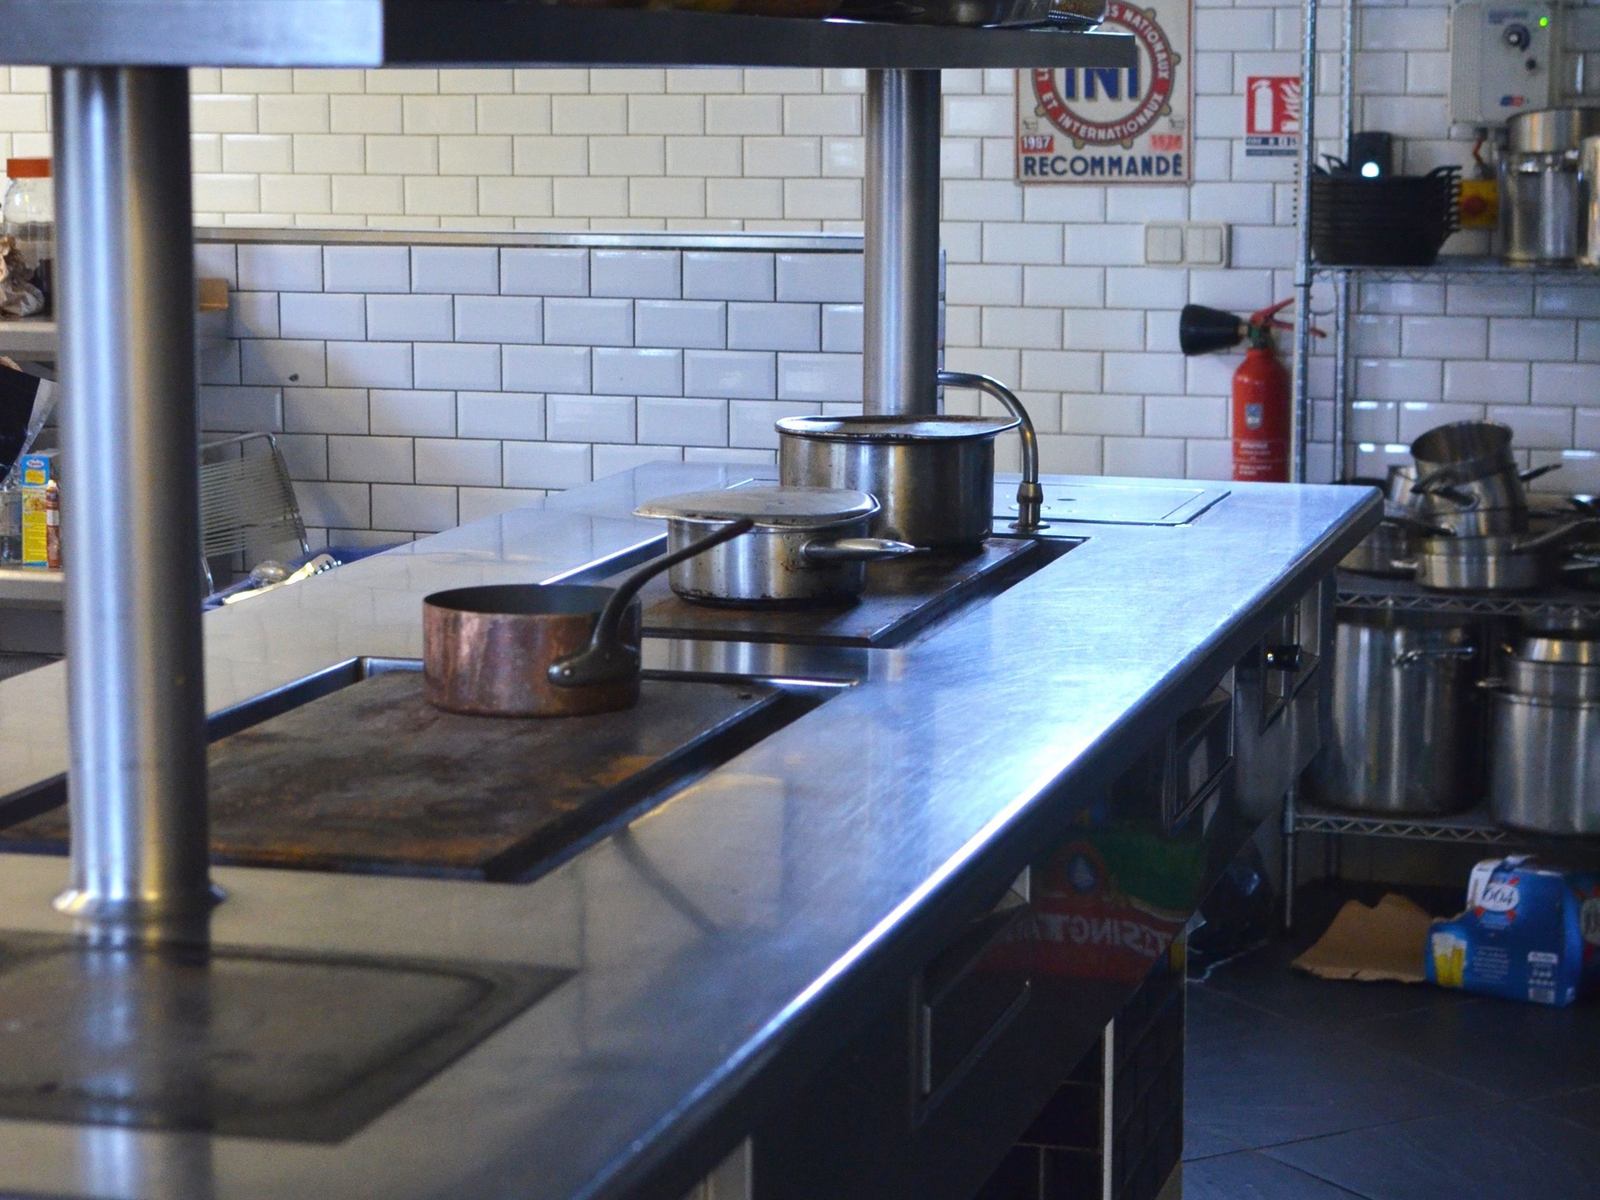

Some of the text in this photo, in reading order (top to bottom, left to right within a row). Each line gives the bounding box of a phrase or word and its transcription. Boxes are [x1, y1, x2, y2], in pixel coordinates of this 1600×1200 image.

[1123, 9, 1170, 80] NATIONAUX
[1042, 93, 1164, 140] ET INTERNATIONAUX
[1024, 153, 1183, 177] RECOMMANDÉ
